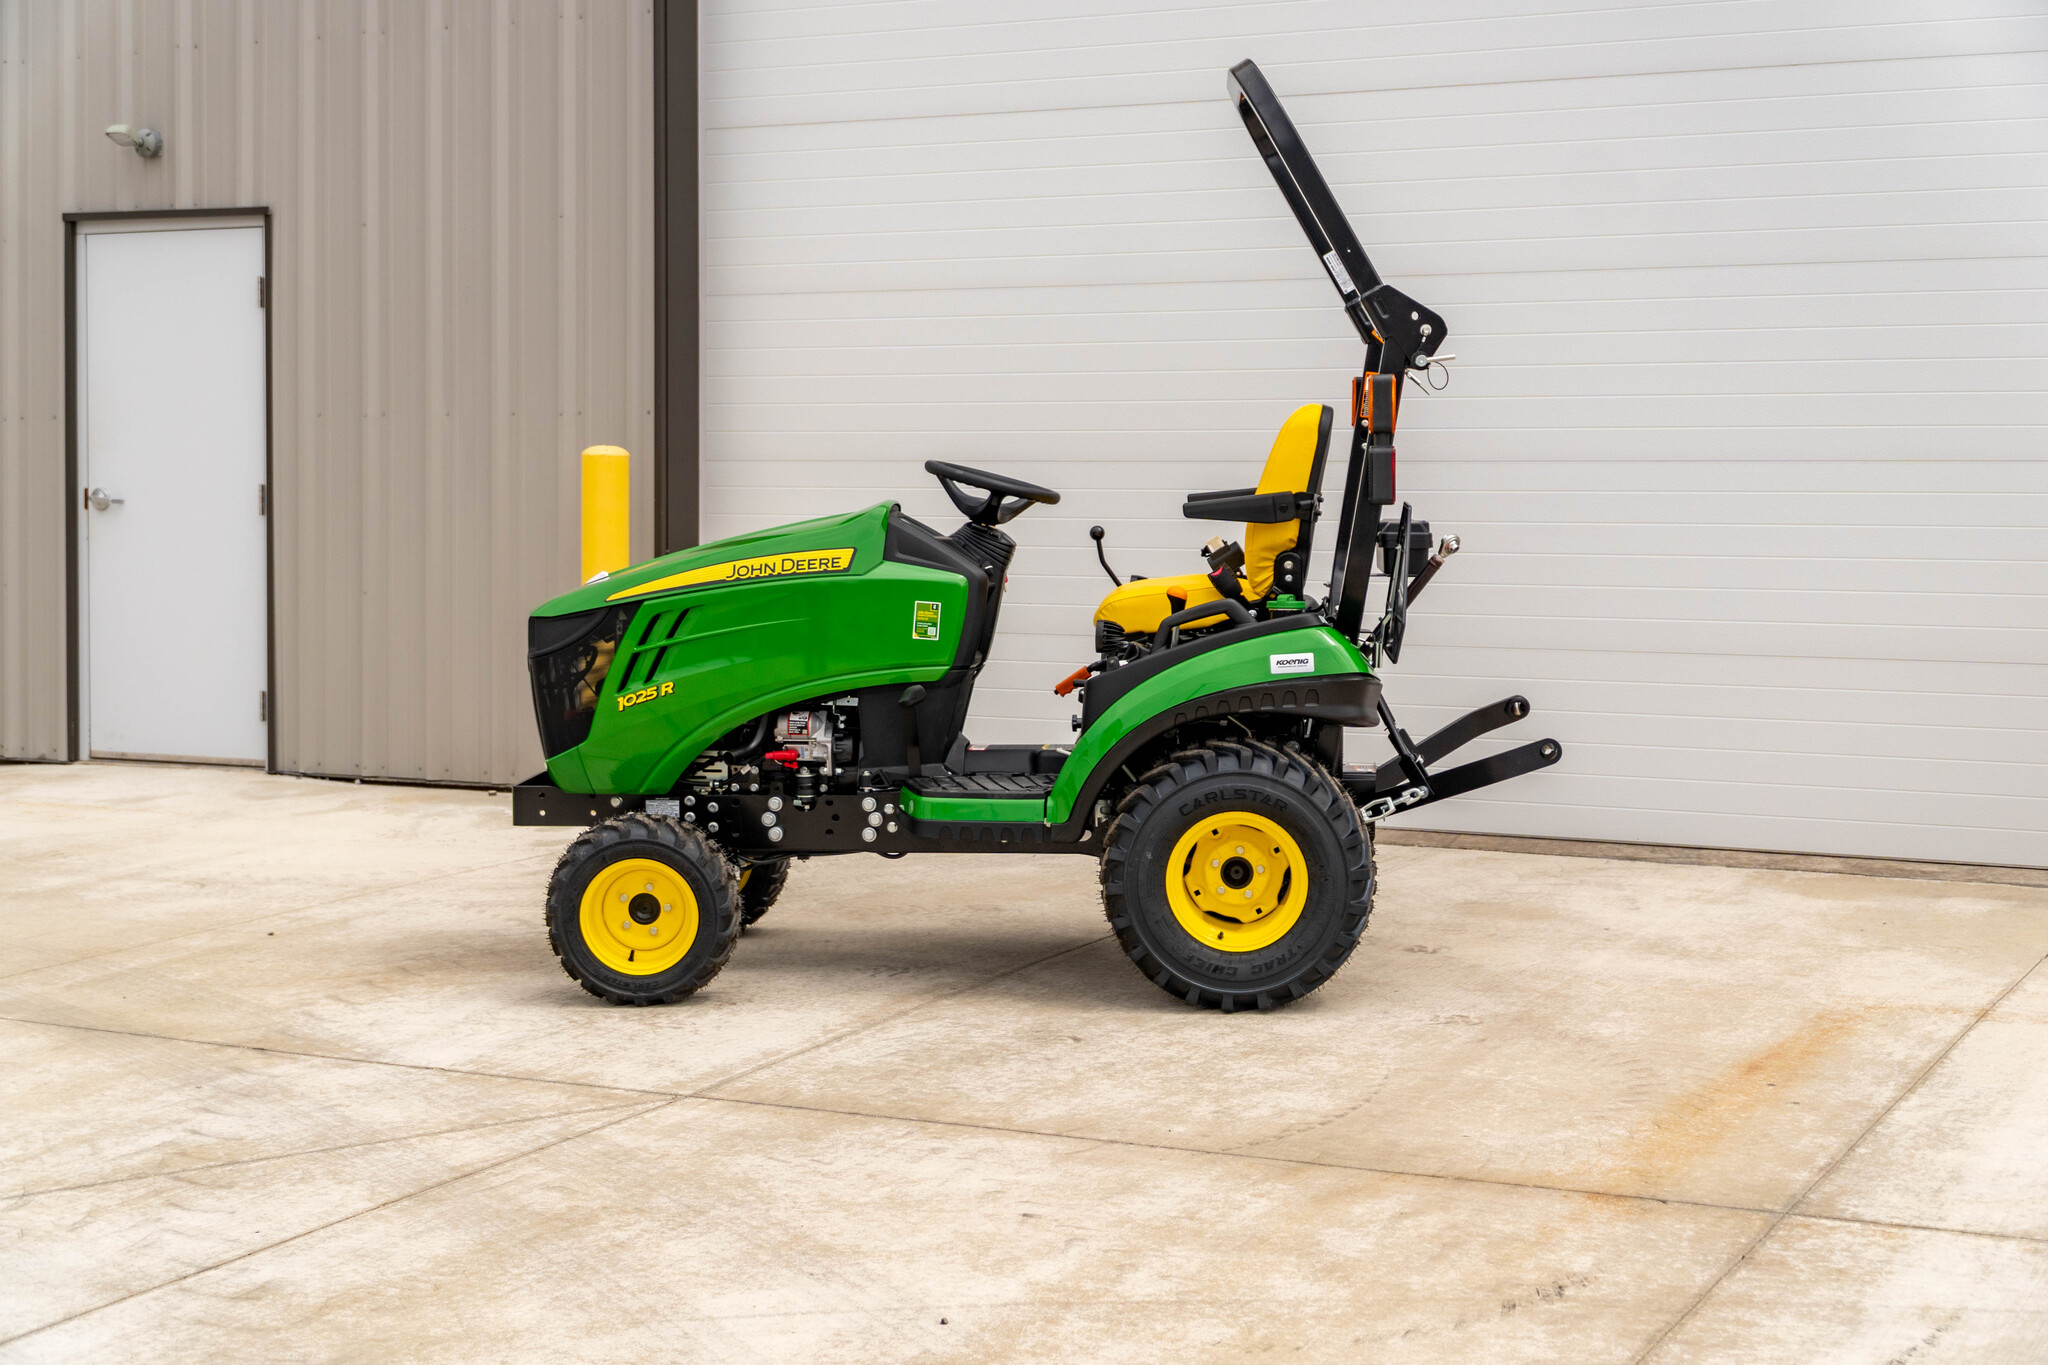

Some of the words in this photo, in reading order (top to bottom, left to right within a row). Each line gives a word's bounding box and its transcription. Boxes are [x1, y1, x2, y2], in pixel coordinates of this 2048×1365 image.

[726, 562, 776, 579] JOHN
[781, 557, 842, 573] DEERE
[617, 686, 658, 712] 1025
[661, 681, 675, 697] R
[1178, 789, 1289, 817] CARLSTAR
